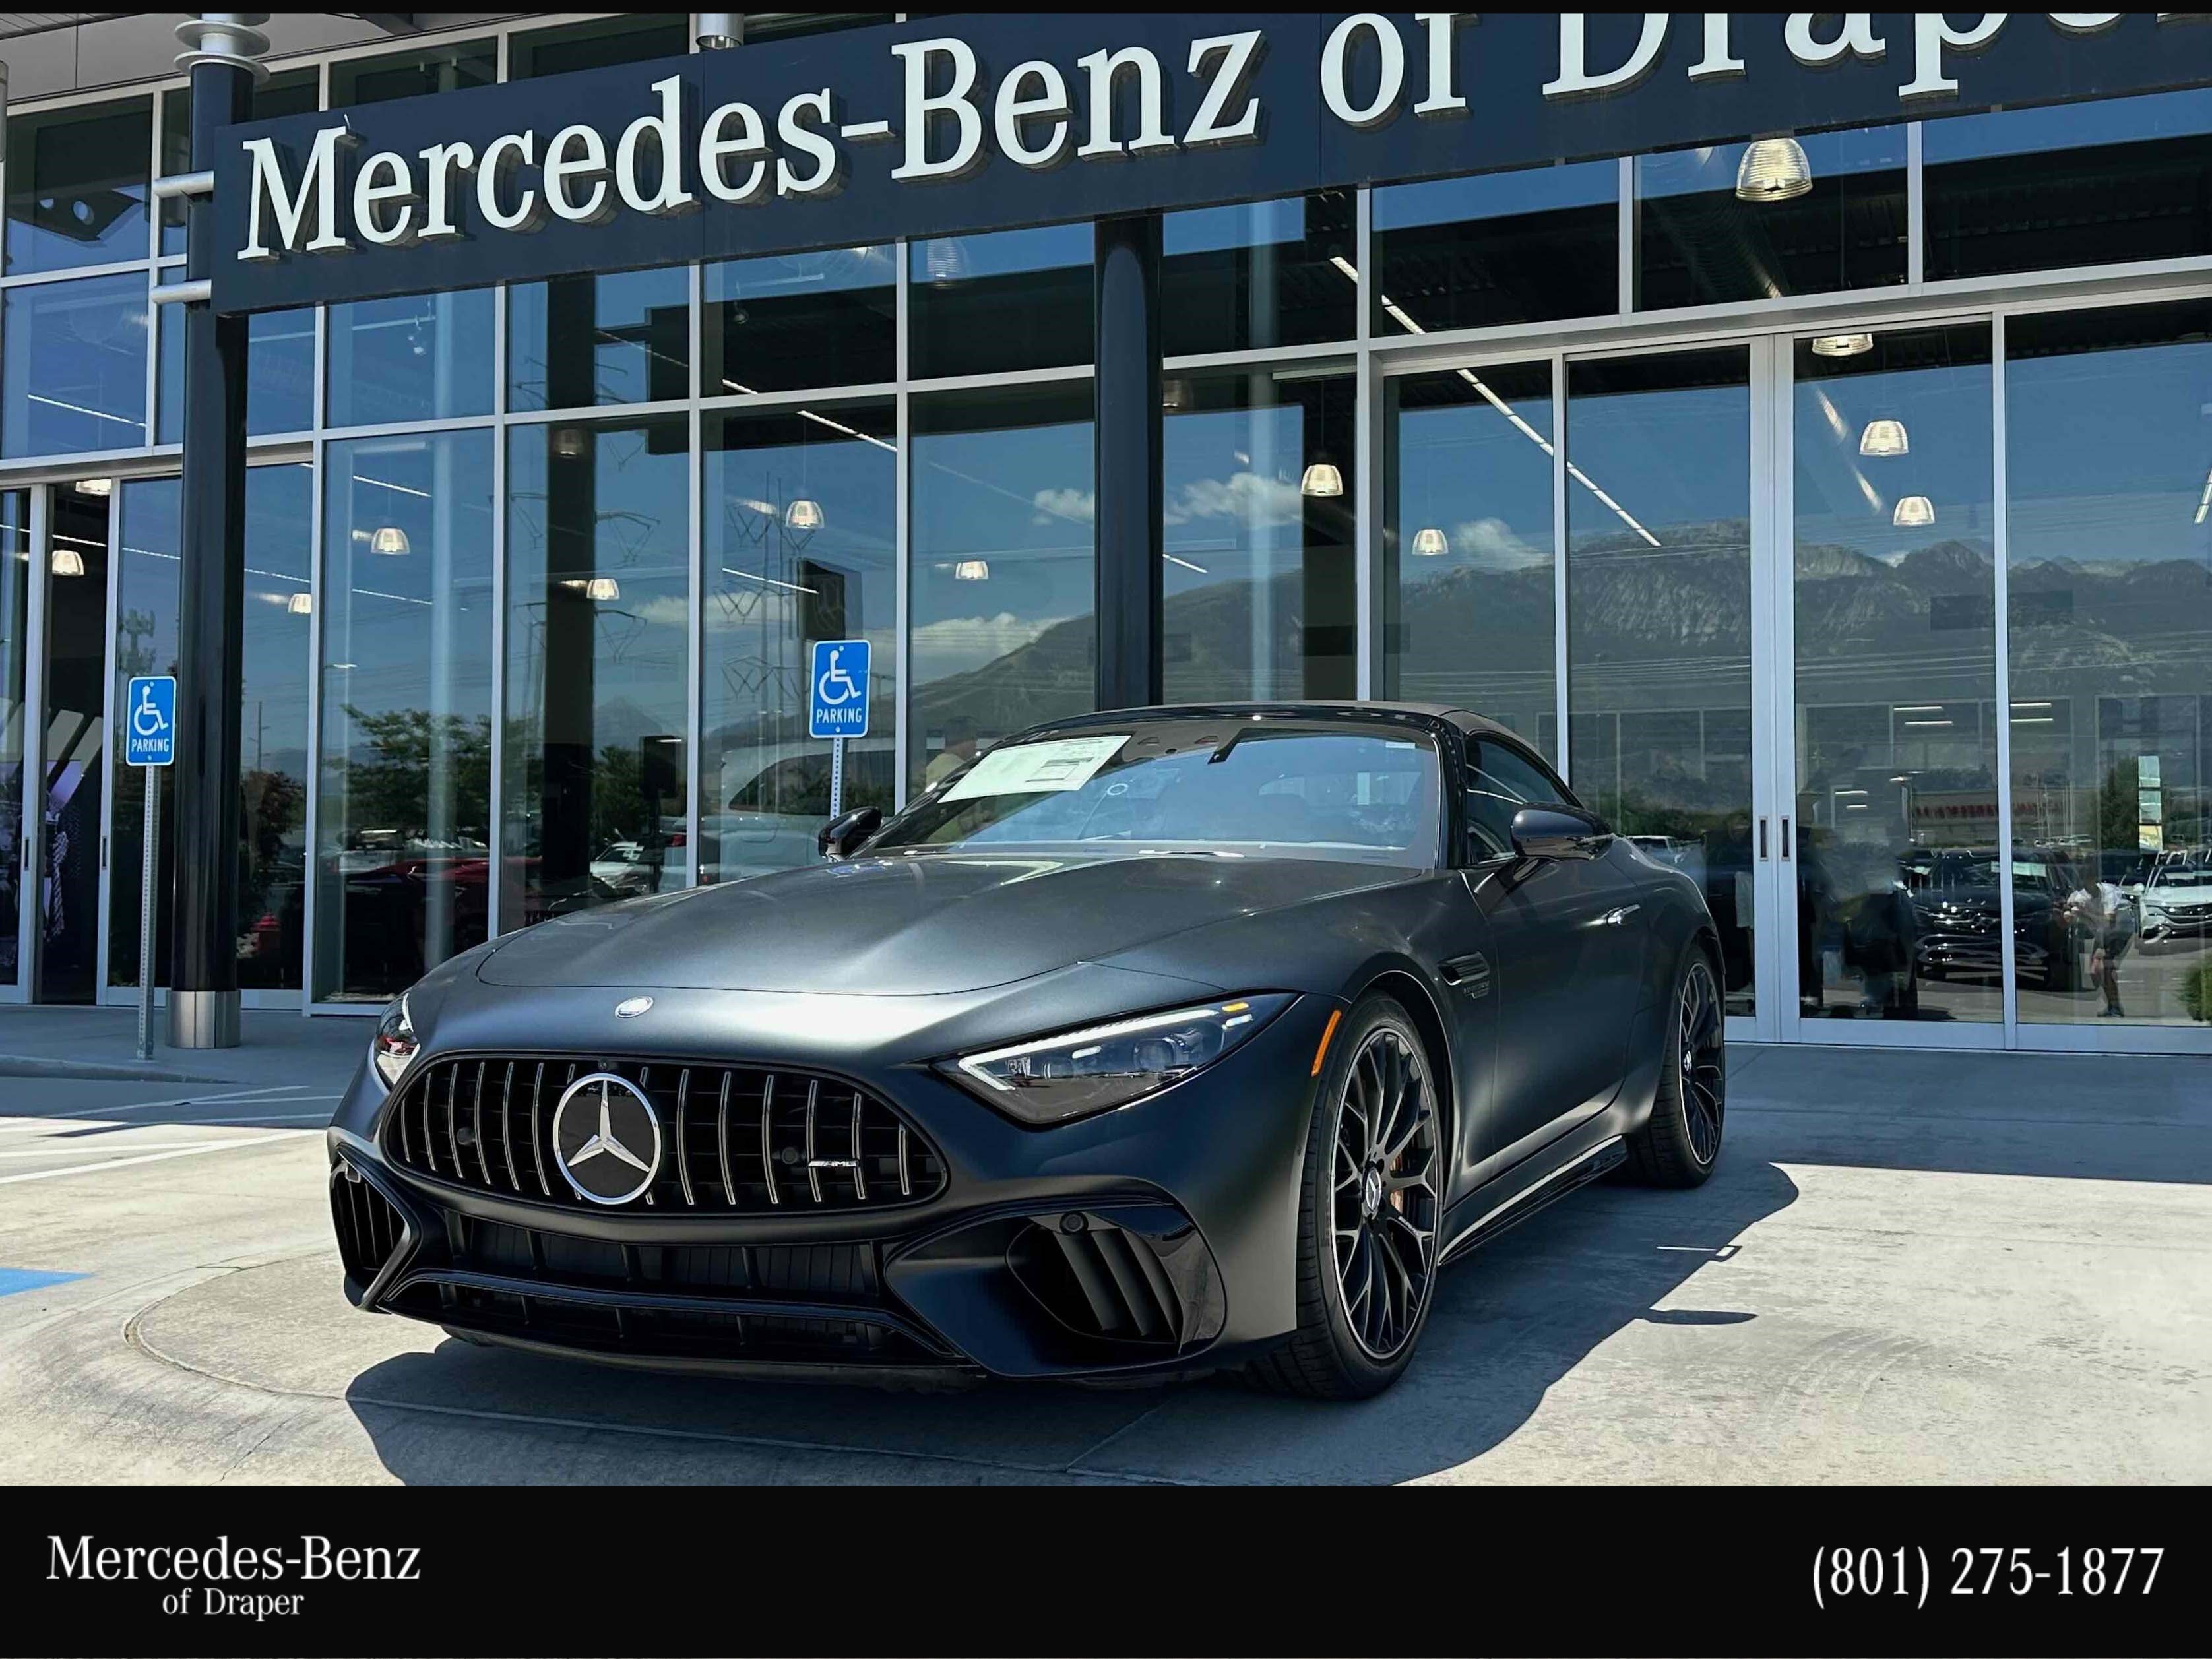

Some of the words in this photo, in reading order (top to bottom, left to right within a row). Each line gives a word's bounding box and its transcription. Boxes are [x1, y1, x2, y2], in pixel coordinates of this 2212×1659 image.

[237, 30, 1261, 259] Mercedes-Benz
[816, 708, 862, 724] PARKING
[131, 738, 170, 752] PARKING
